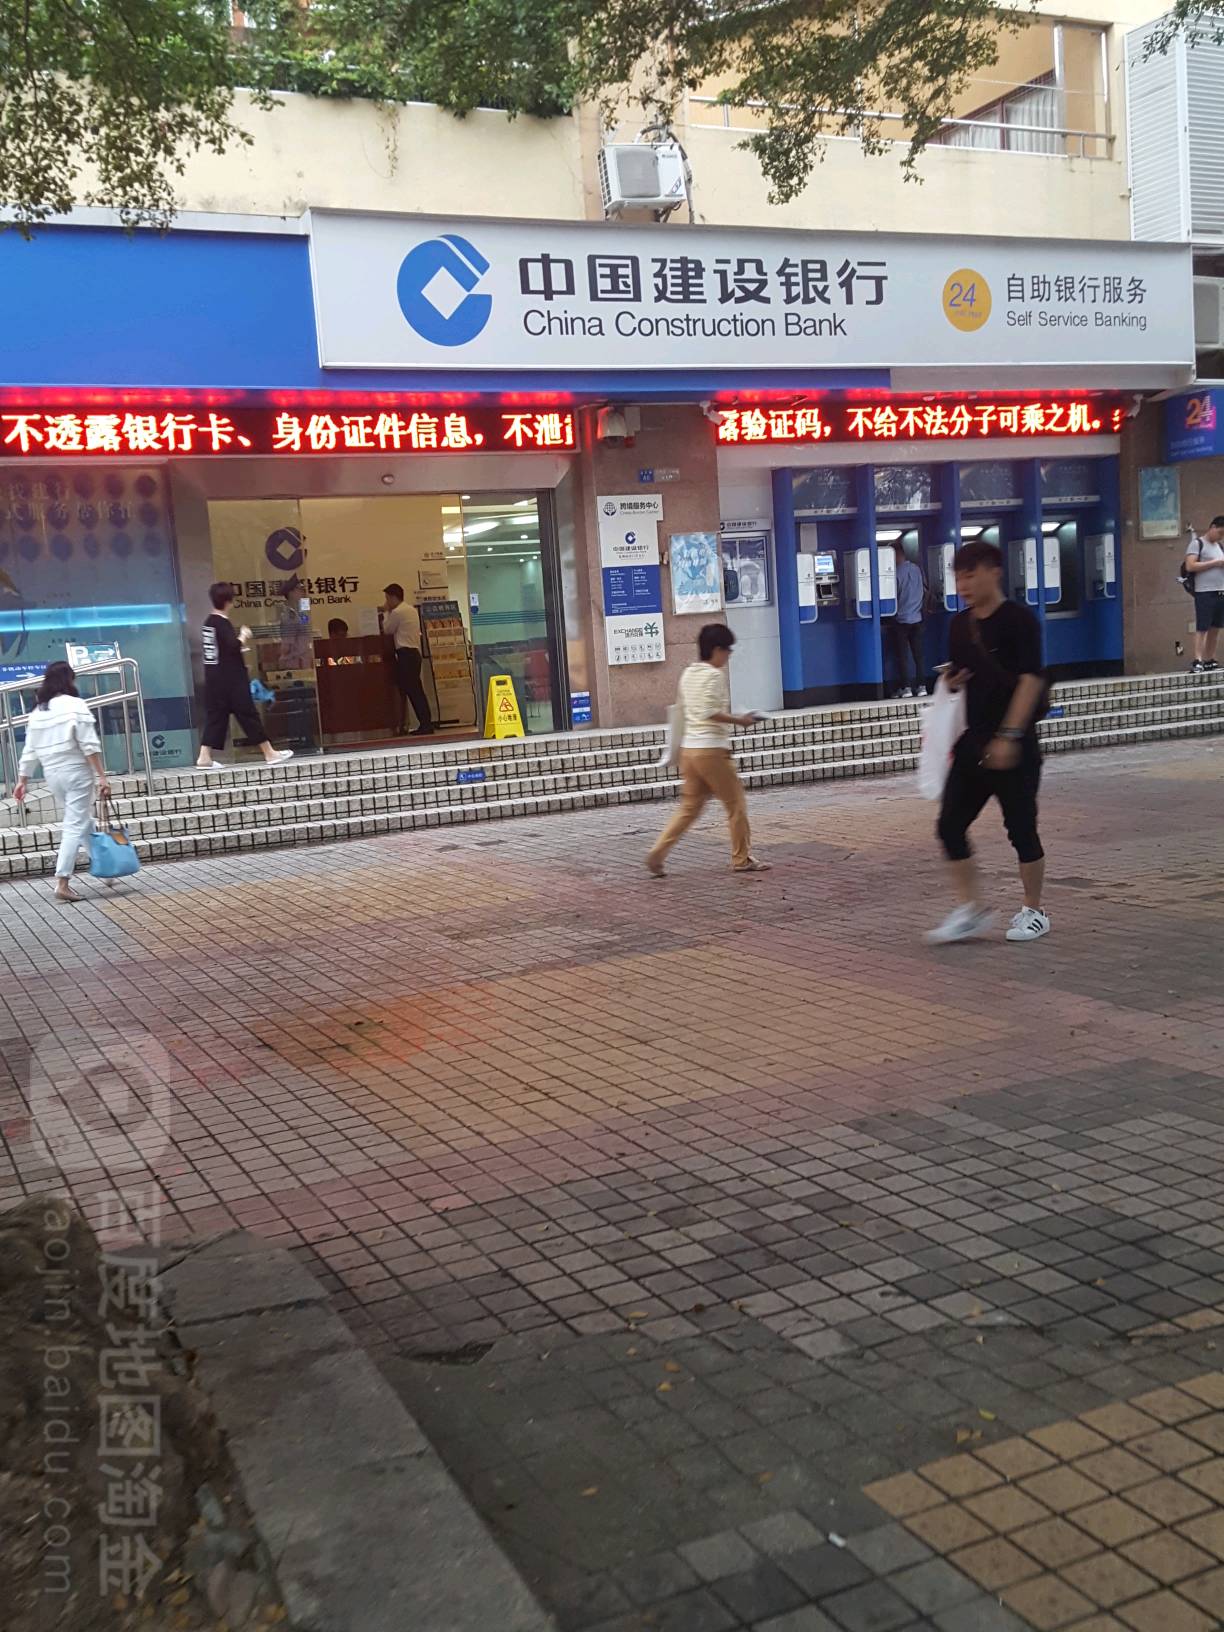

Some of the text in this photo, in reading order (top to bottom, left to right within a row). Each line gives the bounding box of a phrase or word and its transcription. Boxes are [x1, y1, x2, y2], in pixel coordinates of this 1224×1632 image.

[518, 253, 888, 306] 中国建设银行
[1006, 273, 1147, 304] 自助银行服务
[949, 283, 976, 309] 24
[523, 309, 847, 337] China Construction Bank
[1006, 310, 1147, 331] Self Service Banking
[327, 594, 352, 604] Bank
